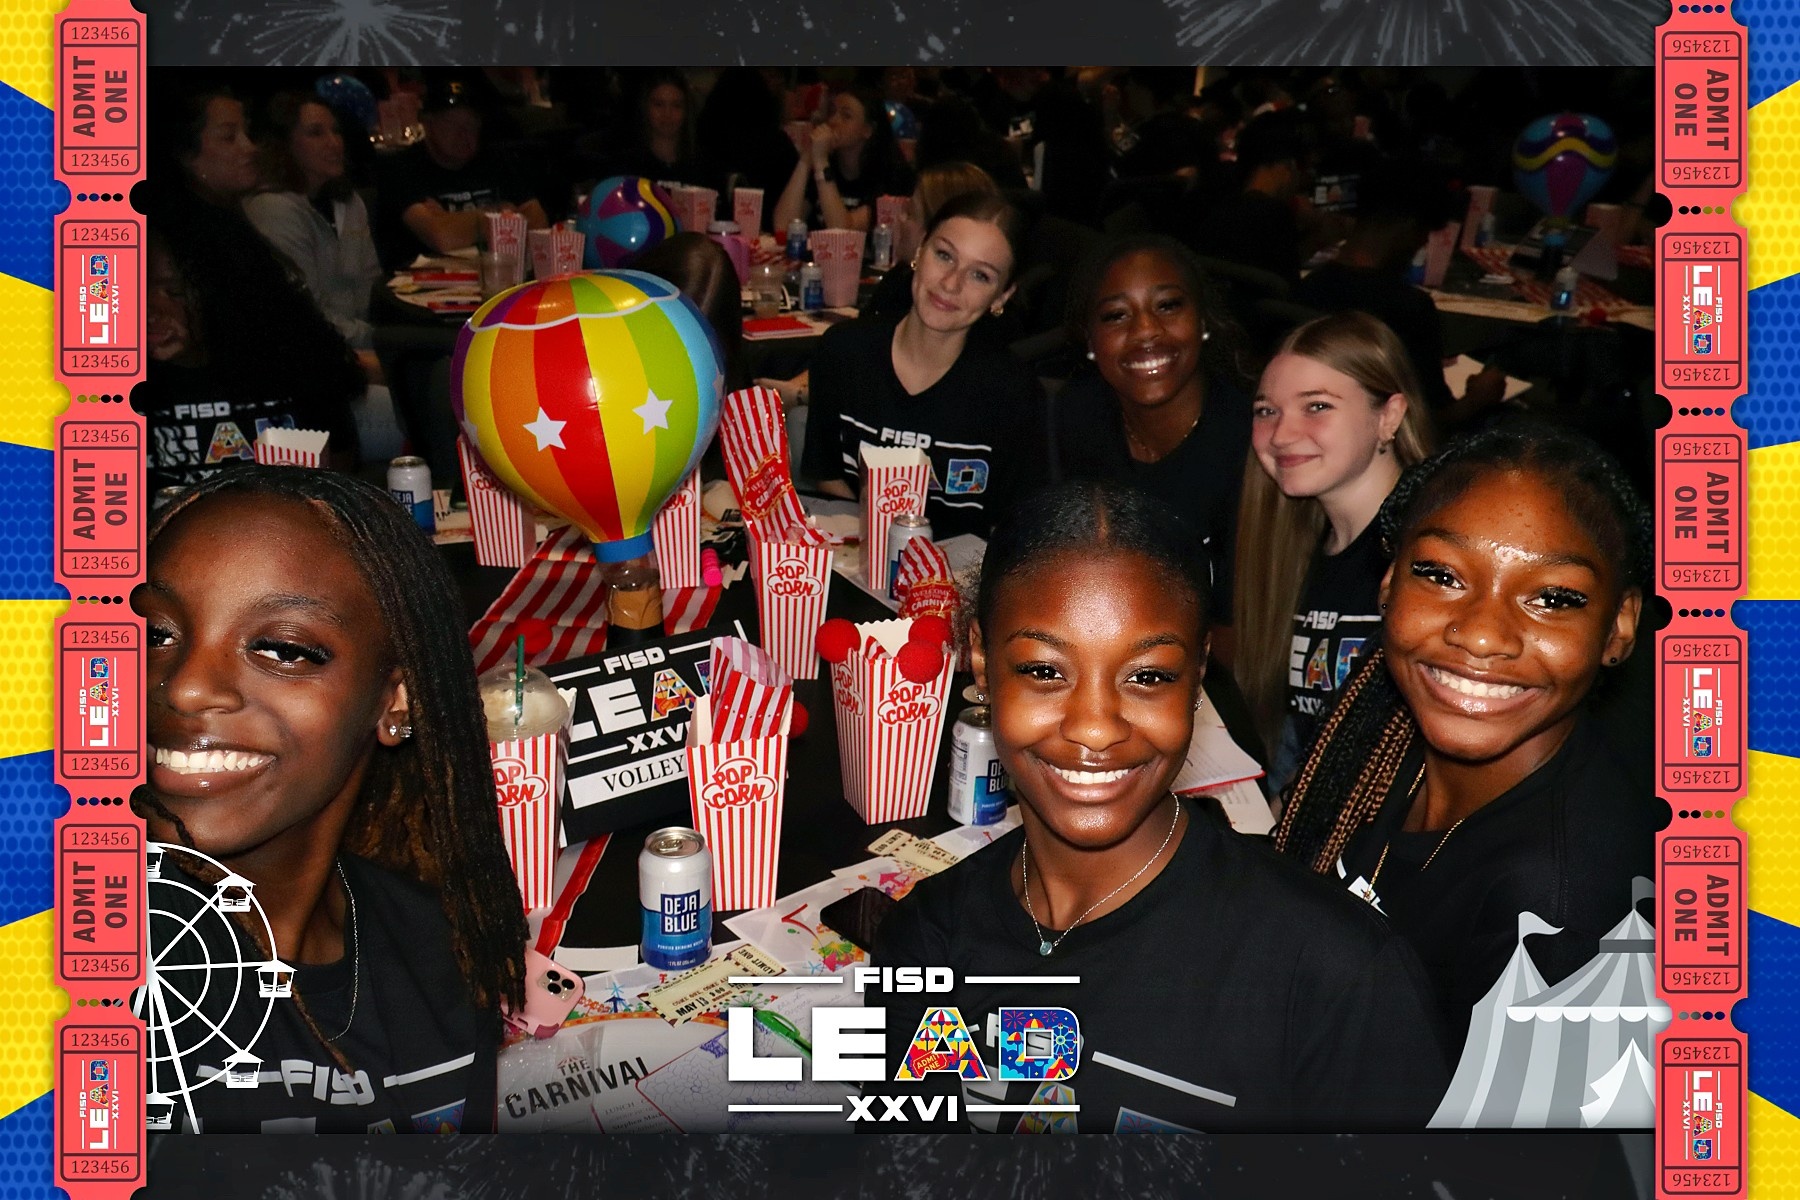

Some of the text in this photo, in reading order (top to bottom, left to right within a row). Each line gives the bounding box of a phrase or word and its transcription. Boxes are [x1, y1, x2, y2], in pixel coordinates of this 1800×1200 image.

[174, 401, 231, 420] FISD
[881, 427, 931, 449] FISD
[884, 484, 908, 500] POP
[881, 498, 914, 514] CORN
[775, 564, 805, 580] POP
[774, 581, 814, 597] CORN
[603, 647, 665, 675] FISD
[570, 659, 710, 743] EA
[888, 685, 922, 706] POP
[886, 702, 930, 724] CORN
[626, 722, 691, 754] XXV
[493, 766, 521, 786] OP
[713, 766, 753, 789] POP
[496, 784, 536, 805] ORN
[711, 782, 765, 808] CORN
[664, 895, 697, 916] DEJA
[665, 912, 697, 933] BLUE
[738, 949, 776, 975] ADMIT ONE
[675, 1002, 698, 1017] MAY
[558, 1060, 590, 1077] THE
